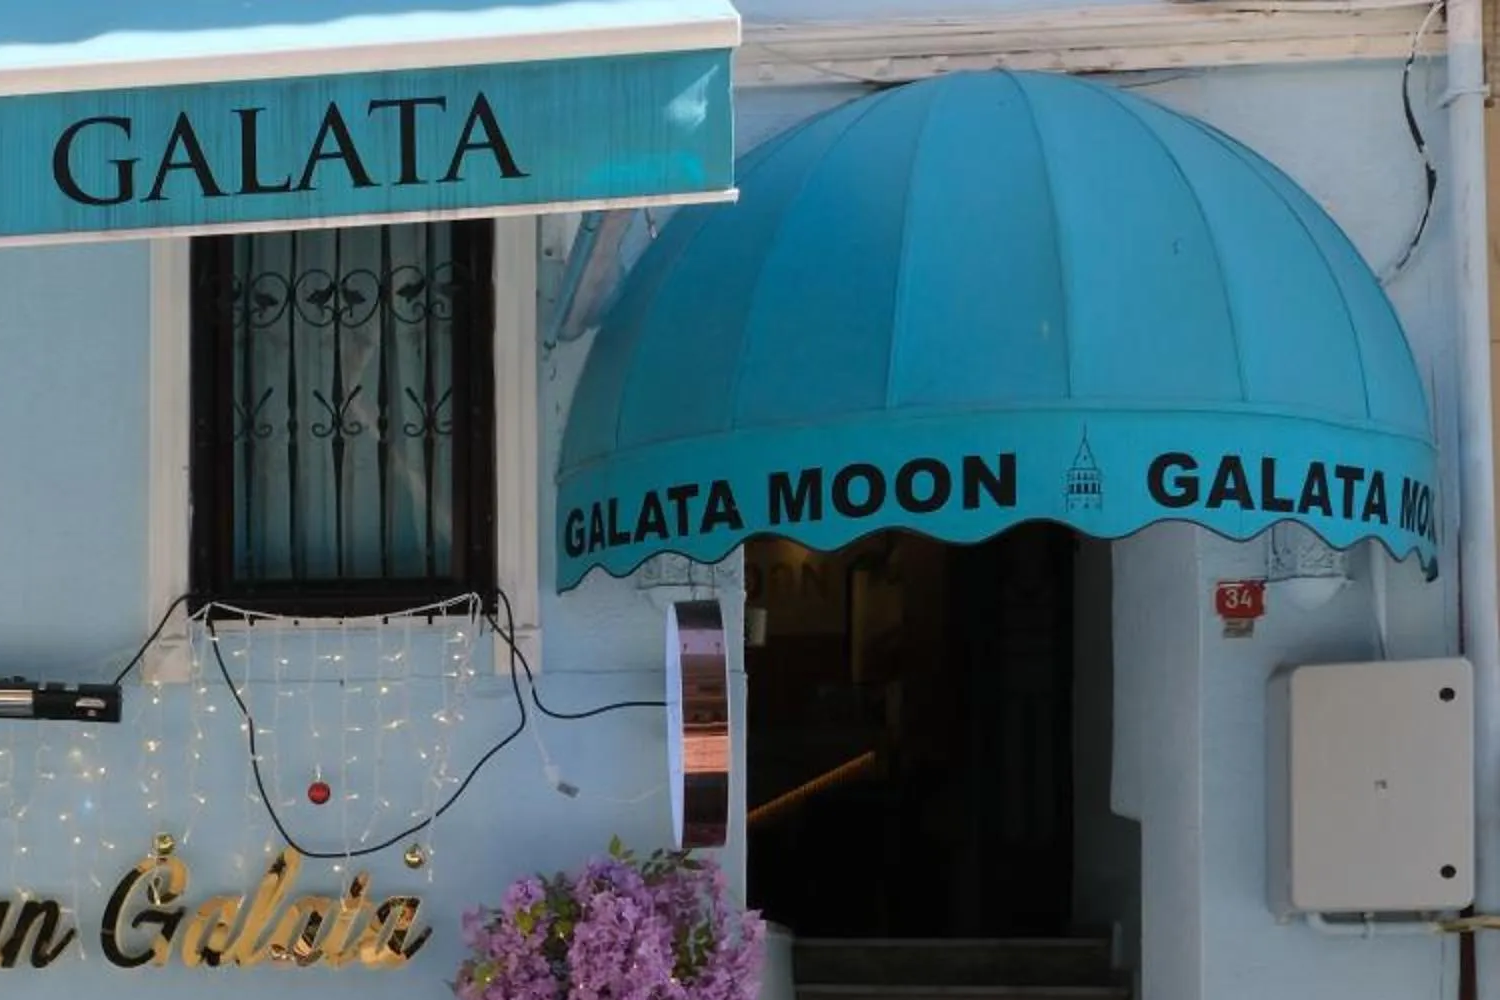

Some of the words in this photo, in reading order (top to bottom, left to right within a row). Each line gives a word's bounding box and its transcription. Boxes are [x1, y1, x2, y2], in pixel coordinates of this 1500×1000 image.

[52, 91, 531, 206] GALATA
[565, 478, 743, 559] GALATA
[768, 453, 1016, 525] MOON
[1147, 451, 1388, 525] GALATA
[1225, 589, 1252, 609] 34
[102, 847, 433, 969] Galata
